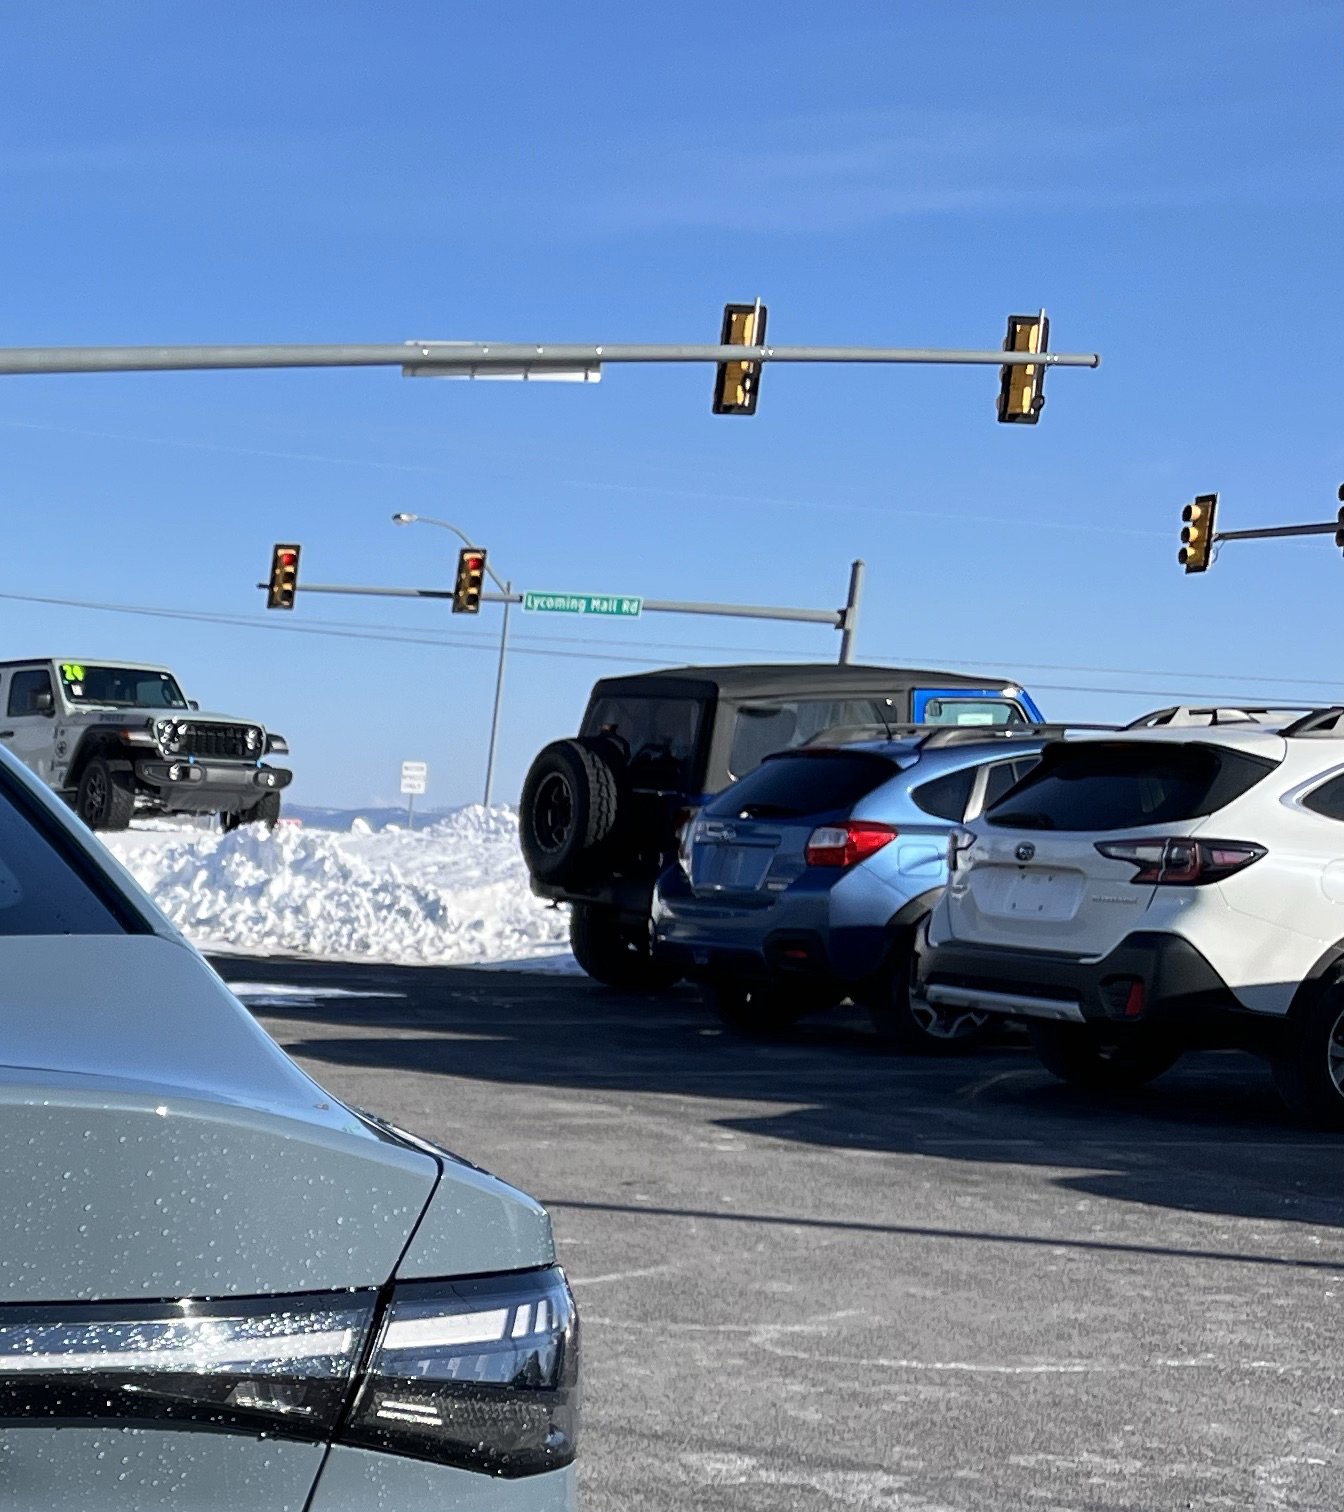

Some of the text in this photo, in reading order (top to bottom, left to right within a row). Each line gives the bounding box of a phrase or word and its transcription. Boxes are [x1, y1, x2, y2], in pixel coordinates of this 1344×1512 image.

[527, 595, 639, 614] Lycoming Mall Rd
